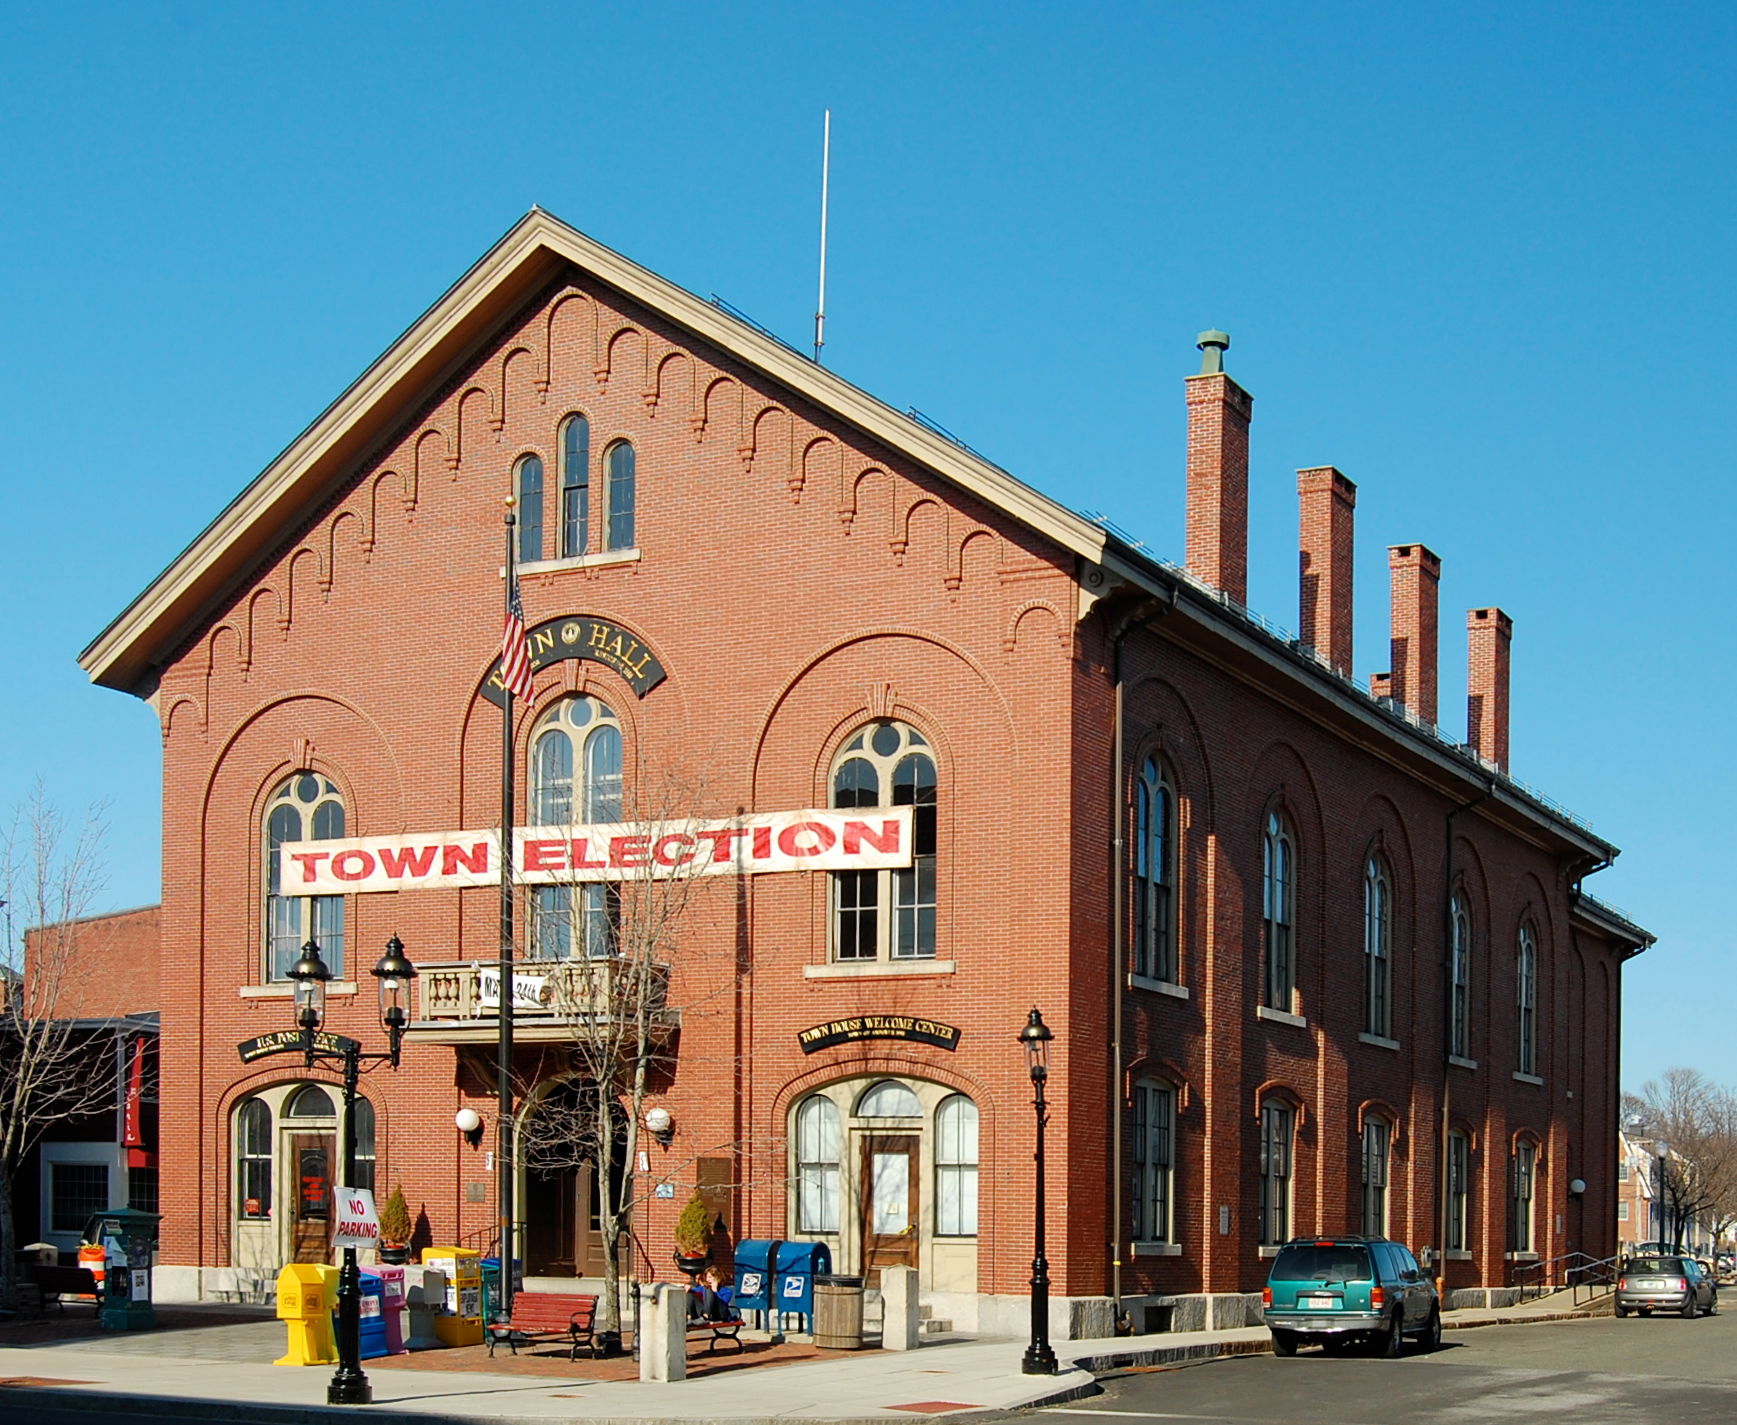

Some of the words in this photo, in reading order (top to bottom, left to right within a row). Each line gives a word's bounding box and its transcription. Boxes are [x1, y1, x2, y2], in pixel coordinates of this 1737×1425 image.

[587, 623, 652, 680] HALL
[291, 842, 488, 883] TOWN
[523, 820, 901, 872] ELECTION
[800, 1024, 829, 1044] TOWN
[831, 1018, 863, 1034] HOUSE
[864, 1017, 914, 1030] WELCOME
[915, 1020, 955, 1040] CENTER
[348, 1200, 365, 1216] NO
[337, 1221, 378, 1238] PARKING
